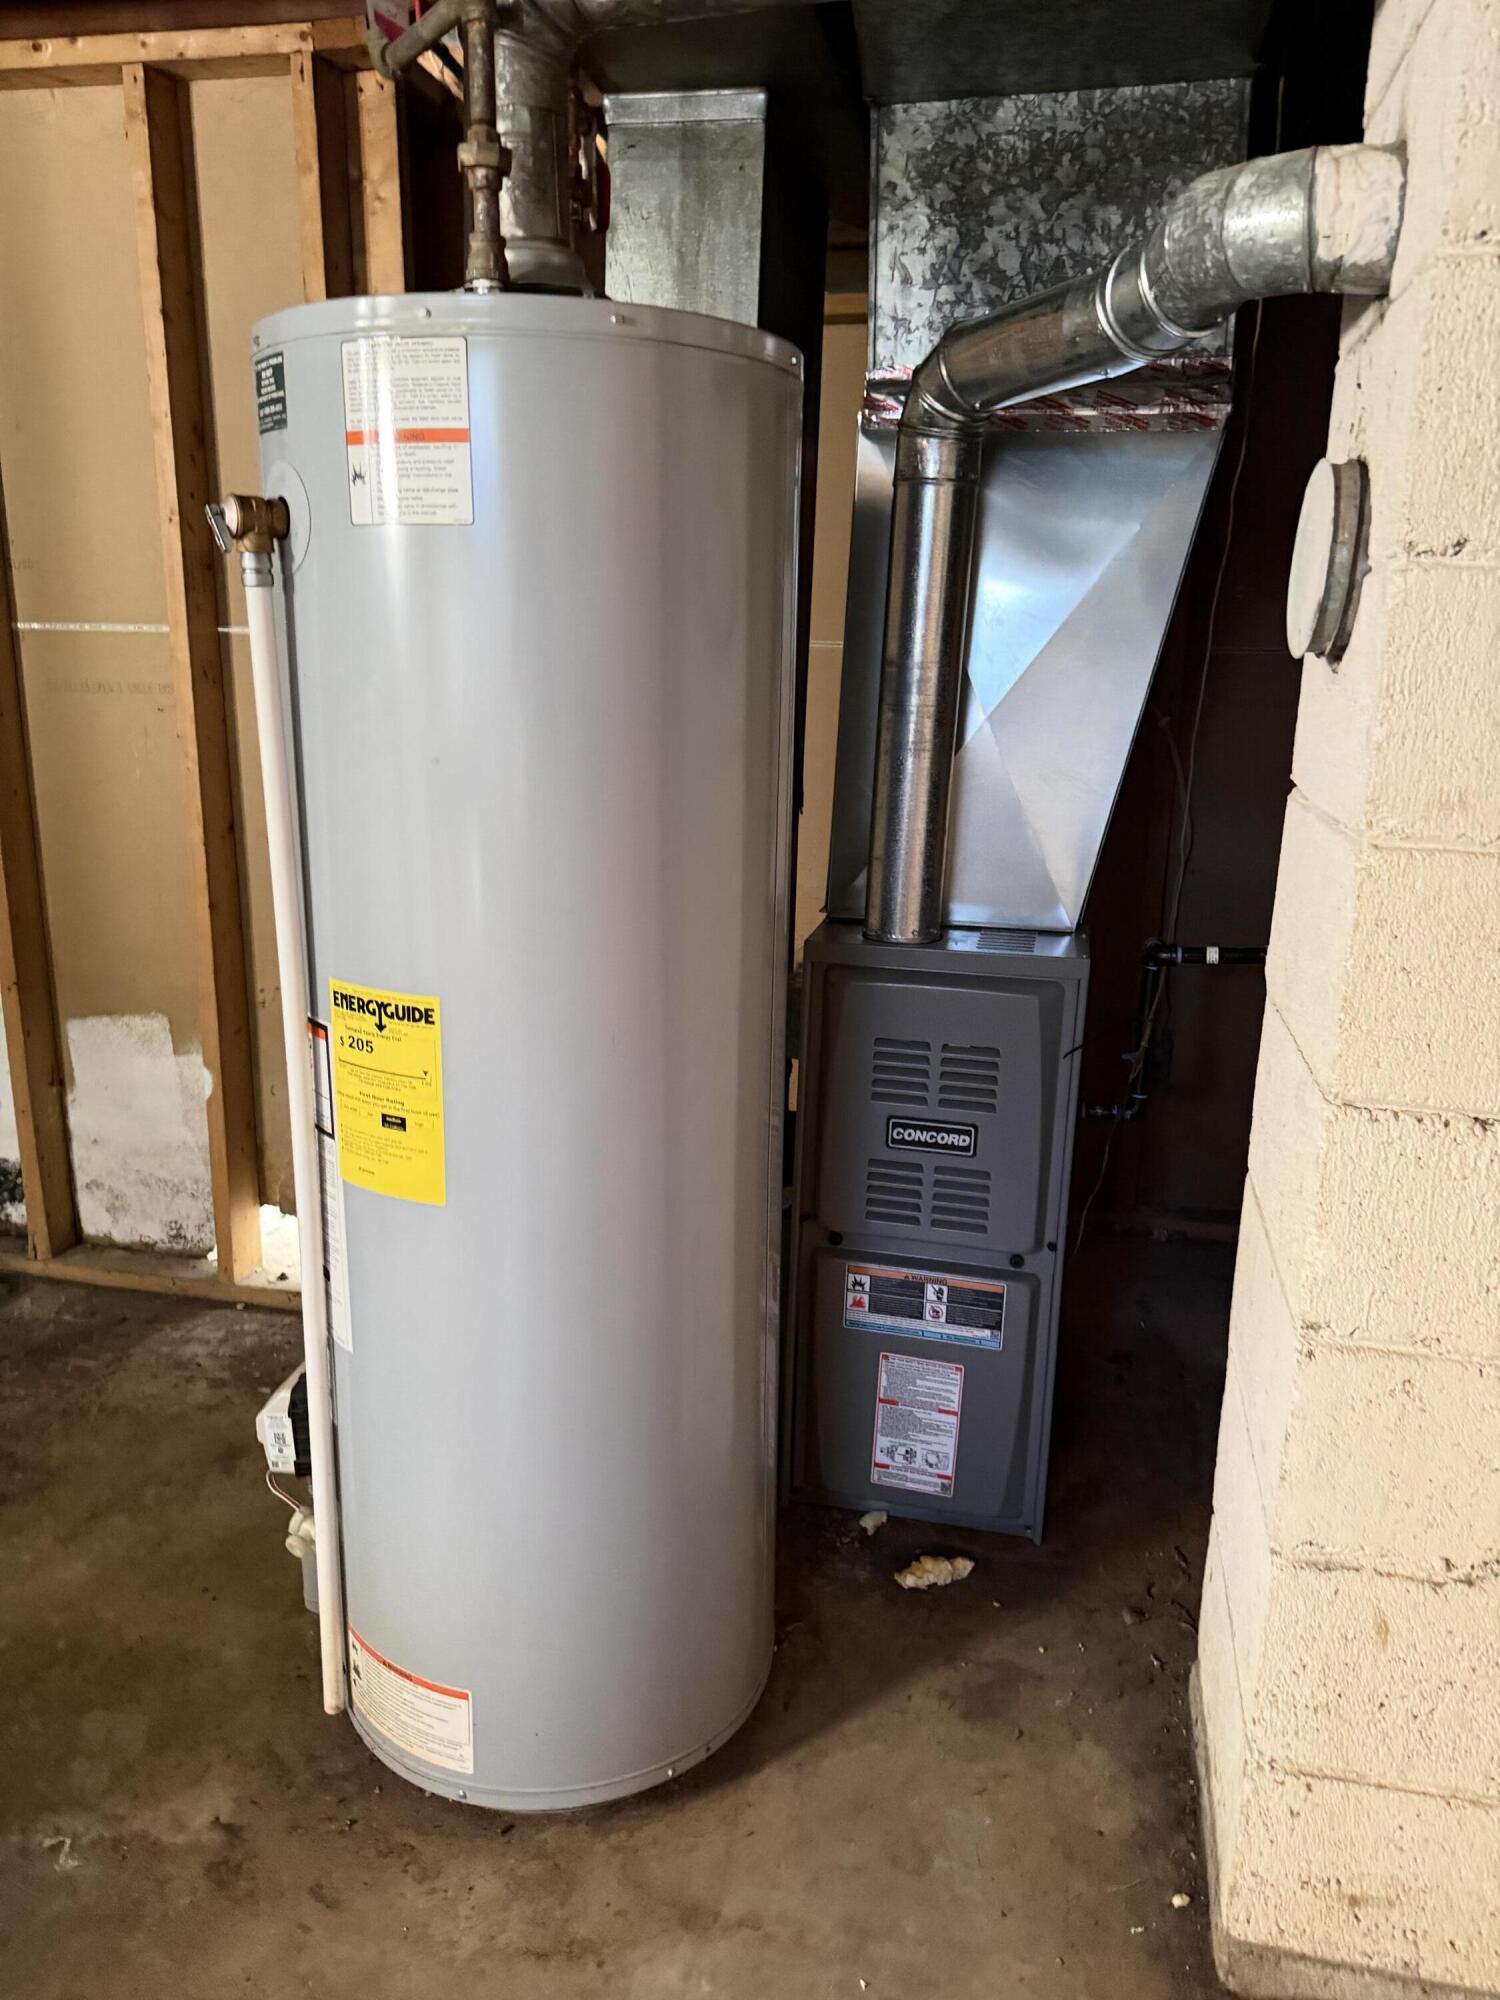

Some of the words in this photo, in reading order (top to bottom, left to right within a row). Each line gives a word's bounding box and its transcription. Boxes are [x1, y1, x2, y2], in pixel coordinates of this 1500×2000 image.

[333, 990, 436, 1026] ENERGYGUIDE
[348, 1035, 374, 1054] 205
[892, 1127, 971, 1147] CONCORD
